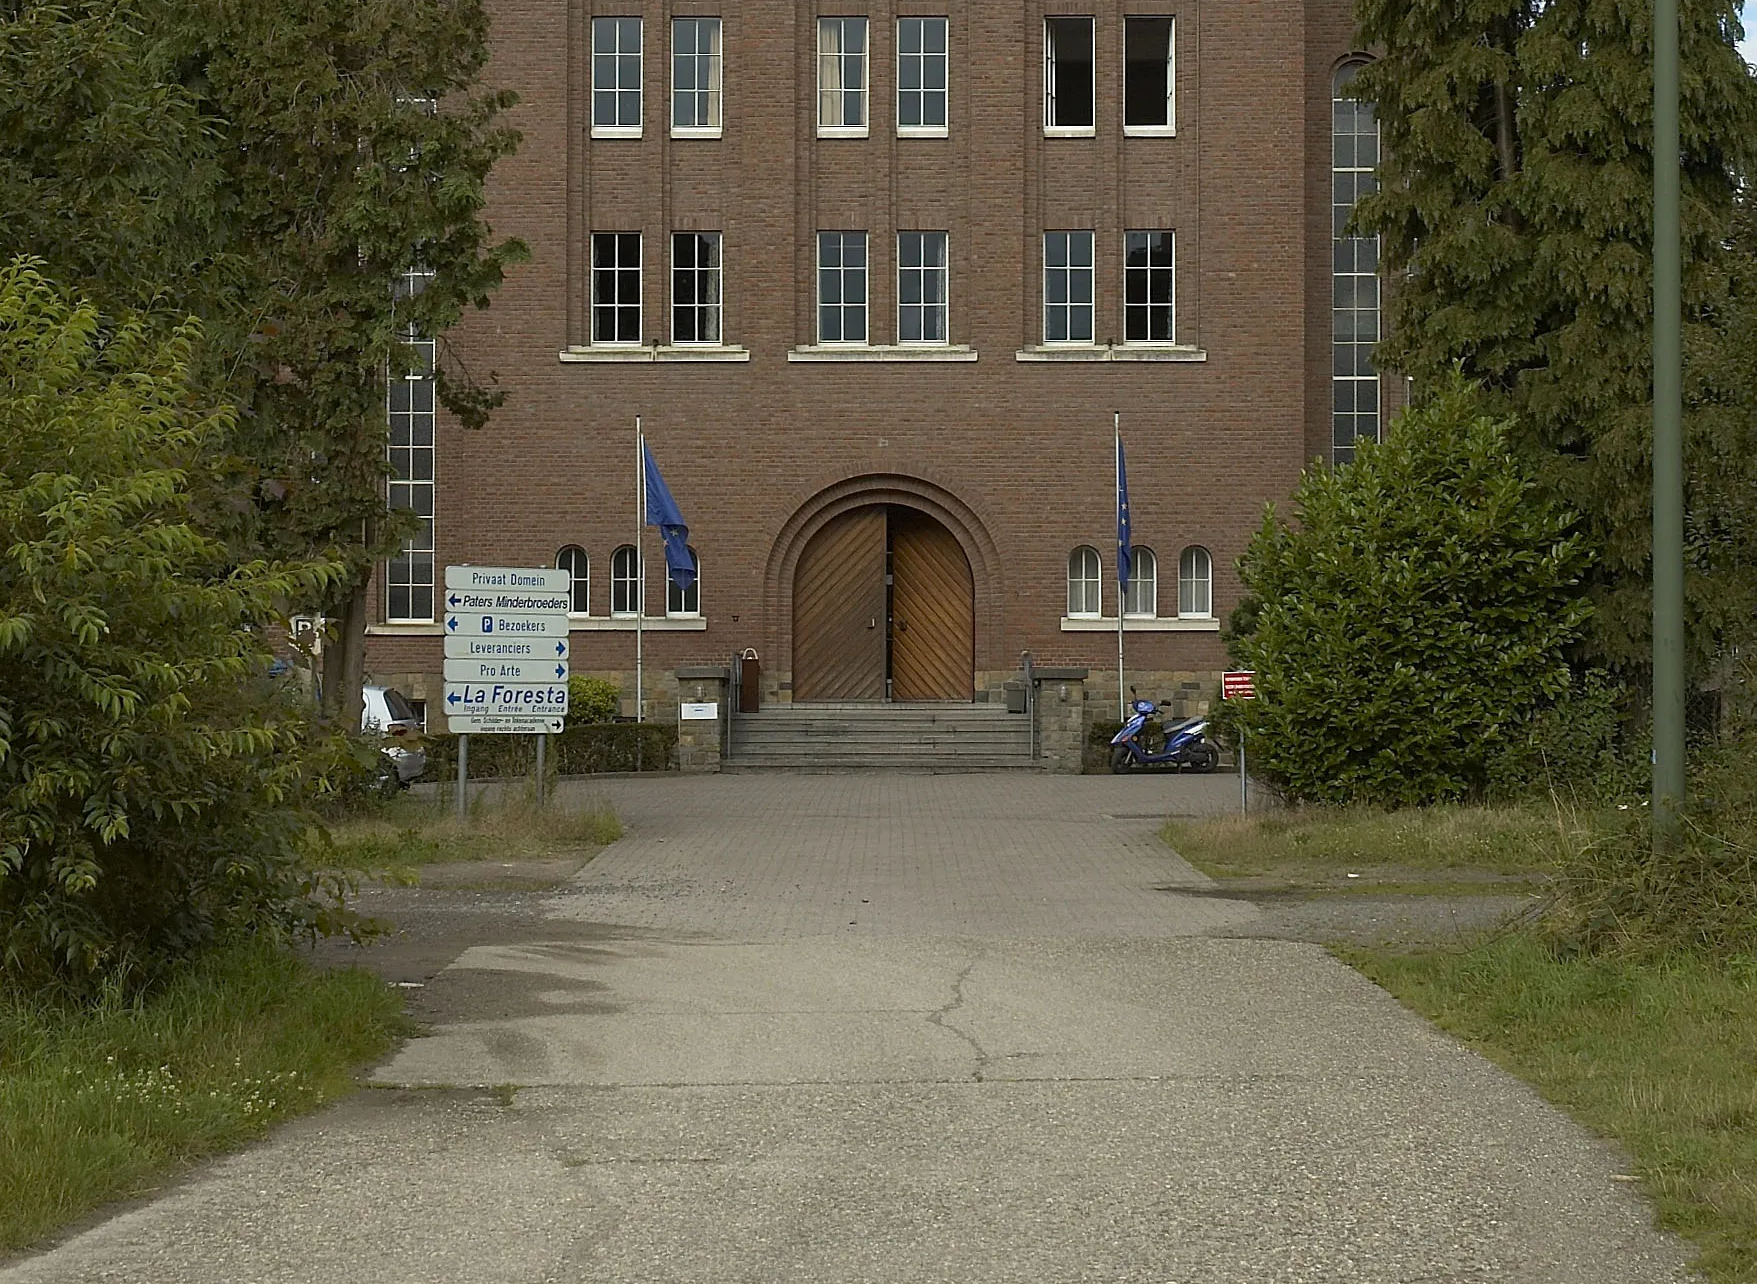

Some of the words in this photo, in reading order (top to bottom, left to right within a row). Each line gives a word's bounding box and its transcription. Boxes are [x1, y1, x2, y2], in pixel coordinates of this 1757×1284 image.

[472, 573, 506, 585] Privaat
[510, 574, 545, 586] Domein
[463, 595, 493, 608] Paters
[496, 596, 568, 610] Minderbroeders
[485, 619, 491, 630] P
[499, 619, 546, 632] Bezoekers
[470, 642, 531, 654] Leveranciers
[480, 665, 496, 676] Pro
[500, 665, 521, 676] Arte
[463, 685, 485, 703] La
[491, 685, 566, 704] Foresta
[463, 705, 489, 715] Ingang
[532, 705, 566, 713] Entrance
